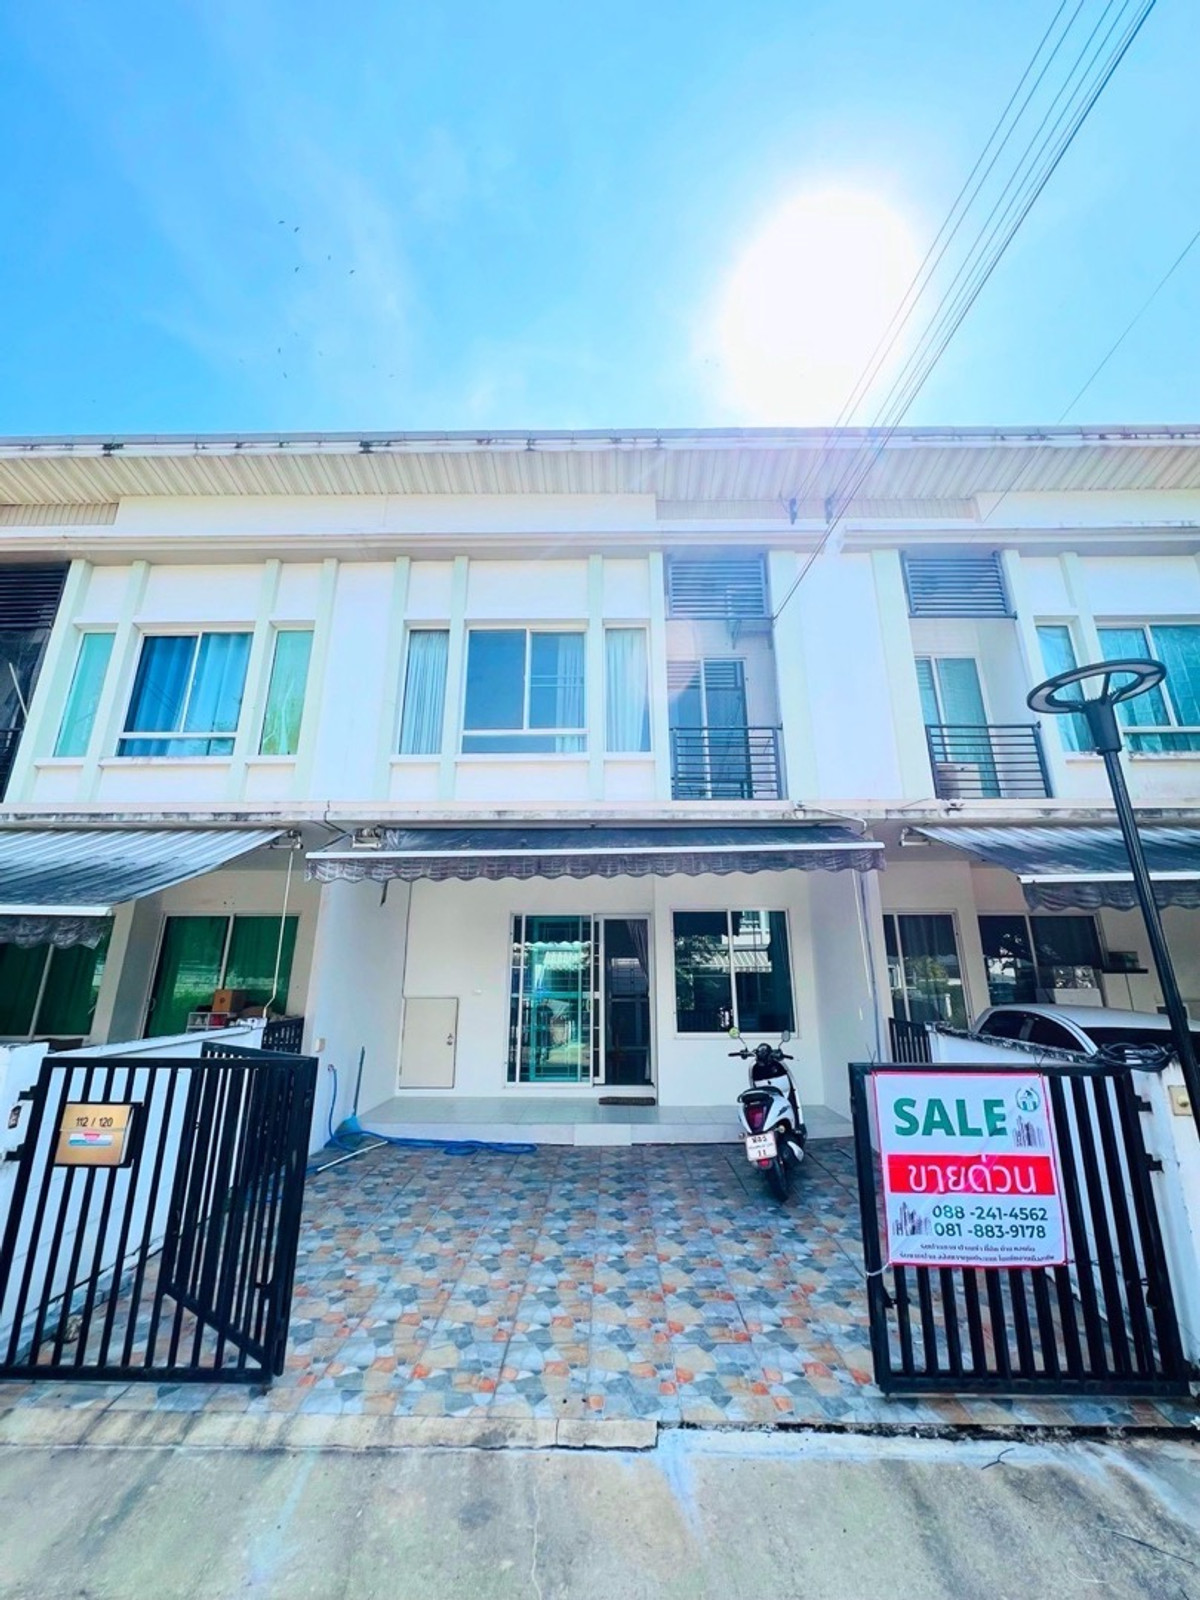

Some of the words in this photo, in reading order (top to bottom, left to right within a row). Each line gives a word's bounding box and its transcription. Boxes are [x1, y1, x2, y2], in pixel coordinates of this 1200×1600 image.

[75, 1116, 89, 1127] 112
[99, 1116, 114, 1128] 120
[893, 1097, 1008, 1137] SALE
[907, 1154, 1037, 1194] ขายด่วน
[932, 1205, 965, 1219] 088
[934, 1222, 962, 1237] 081
